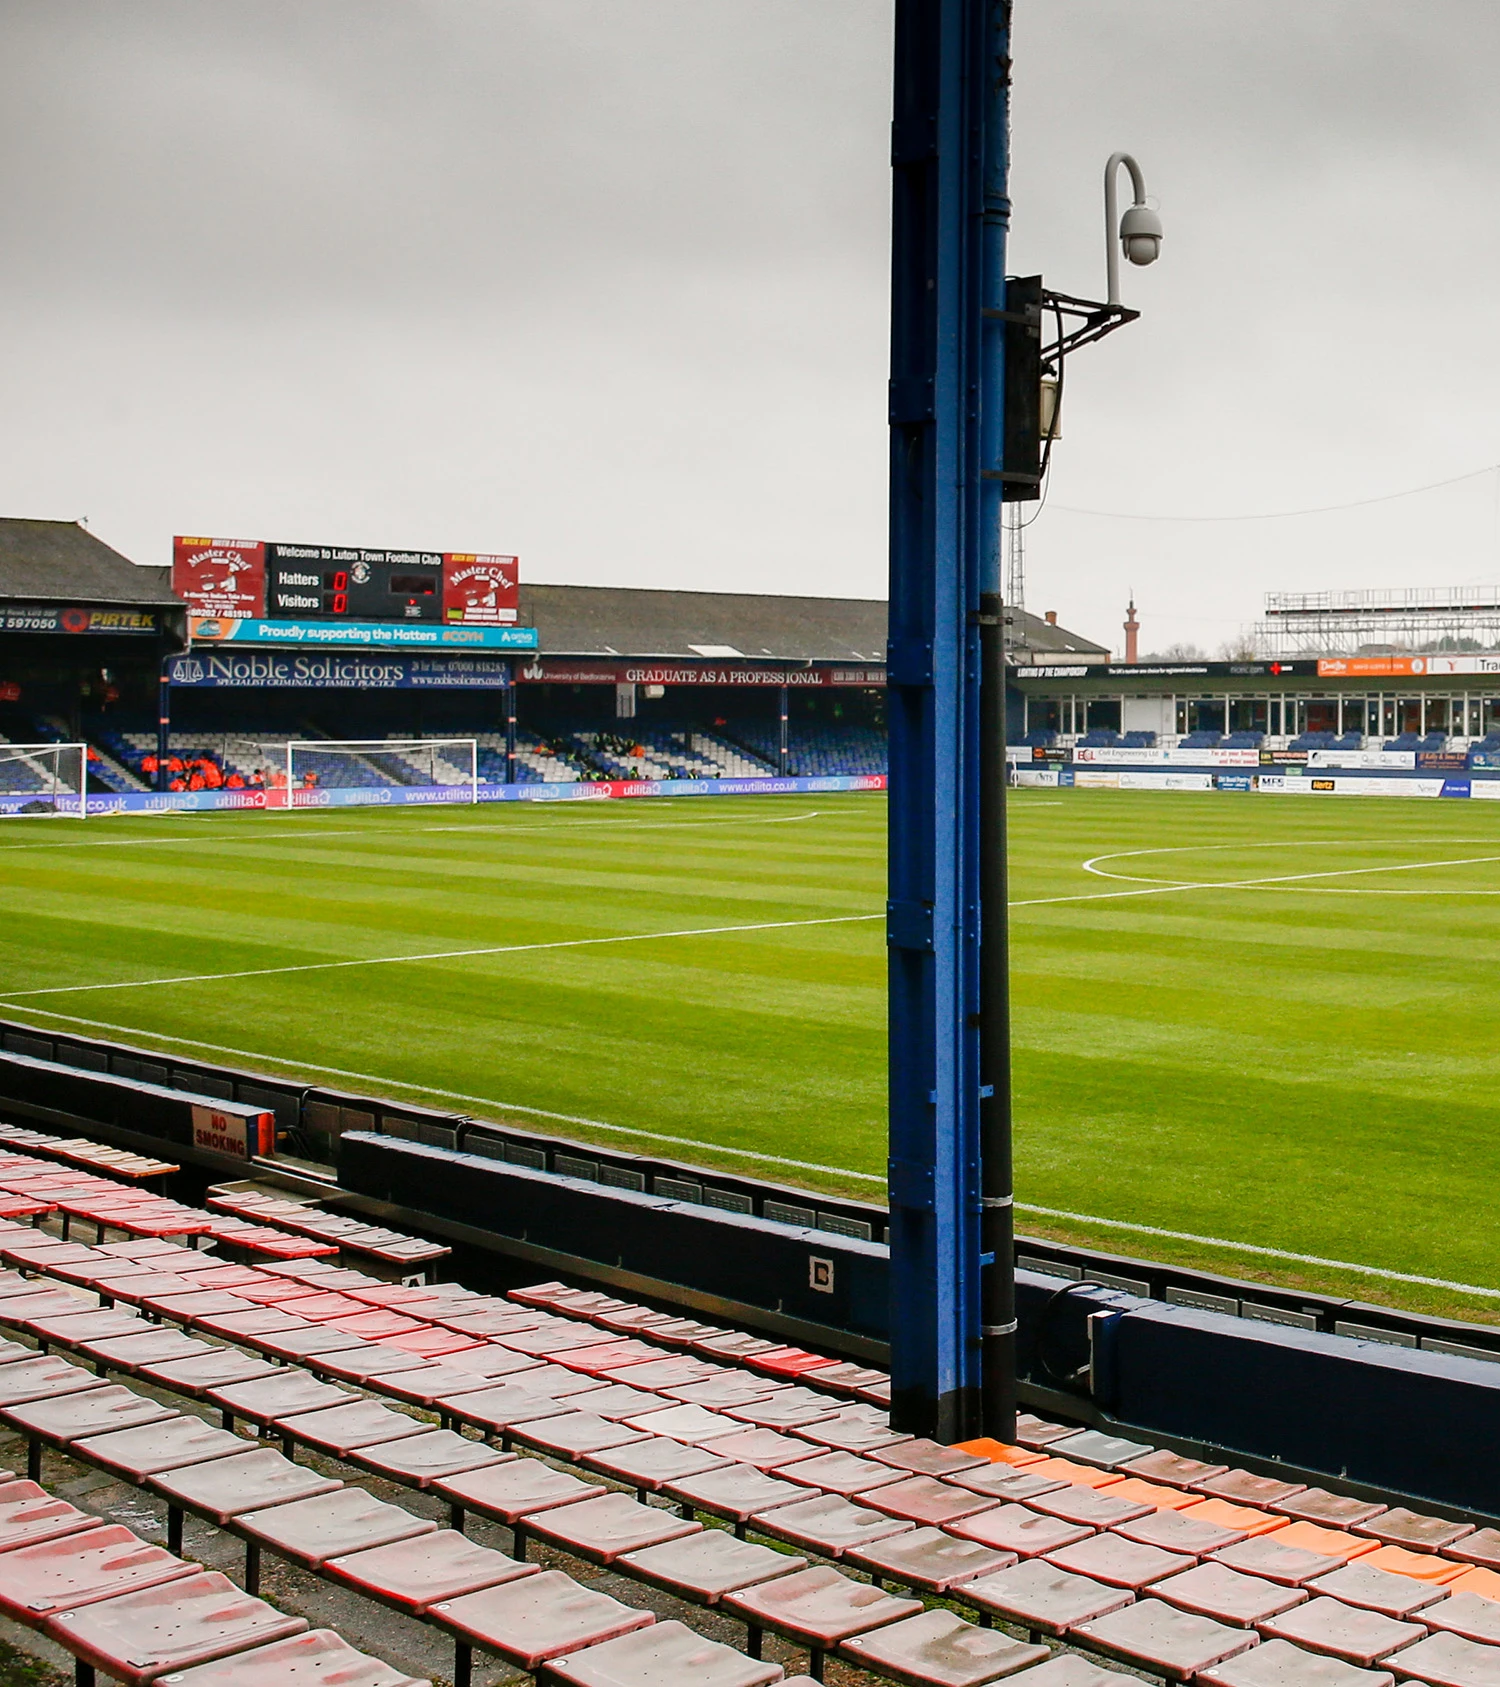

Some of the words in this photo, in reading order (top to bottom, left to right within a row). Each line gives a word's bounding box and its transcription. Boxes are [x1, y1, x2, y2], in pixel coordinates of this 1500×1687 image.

[187, 549, 225, 568] Master
[226, 550, 253, 571] Chef
[276, 545, 320, 559] Welcome
[321, 548, 331, 556] to
[332, 549, 358, 561] Luton
[360, 550, 384, 562] Town
[386, 552, 420, 564] Football
[422, 554, 441, 566] Club
[278, 572, 319, 587] Hatters
[450, 566, 487, 586] Master
[488, 567, 514, 589] Chef
[277, 594, 319, 609] Visitors
[7, 617, 57, 629] 597050
[90, 612, 155, 627] PIRTEK
[259, 624, 303, 640] Proudly
[307, 626, 371, 641] supporting
[373, 629, 392, 640] the
[394, 629, 437, 642] Hatters
[207, 655, 289, 680] Noble
[294, 656, 404, 680] Solicitors
[626, 669, 697, 683] GRADUATE
[700, 670, 716, 683] AS
[718, 671, 727, 683] A
[730, 671, 822, 684] PROFESSIONAL
[215, 794, 254, 807] utilita
[405, 788, 505, 801] www.utilitaco.uk
[719, 779, 798, 792] www.utilita.co.uk
[211, 1114, 227, 1132] NO
[196, 1129, 245, 1155] SMOKING
